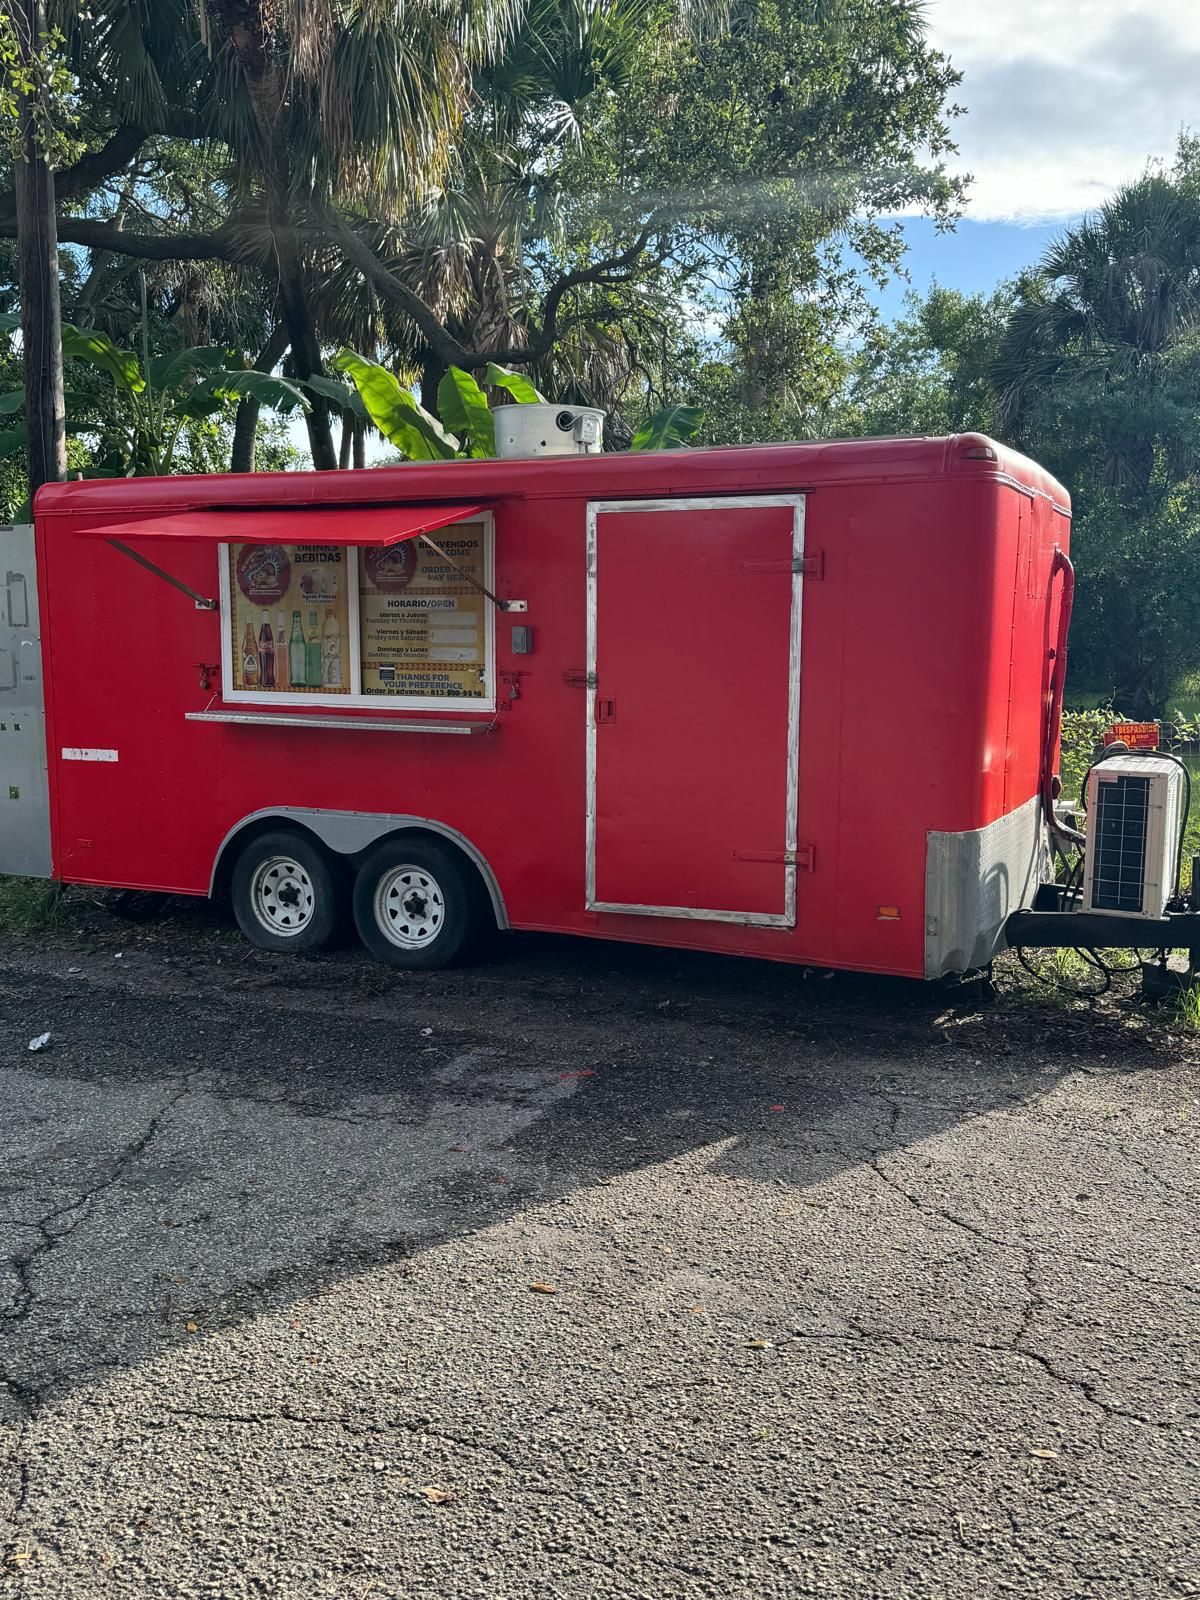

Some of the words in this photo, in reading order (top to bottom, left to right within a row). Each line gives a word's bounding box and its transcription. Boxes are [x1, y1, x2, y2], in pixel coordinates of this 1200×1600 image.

[294, 552, 342, 563] BEBIDAS
[387, 600, 455, 609] HORARIO/OPEN
[396, 673, 431, 681] THANKS
[384, 680, 407, 688] YOUR
[408, 681, 463, 689] PREFERENCE
